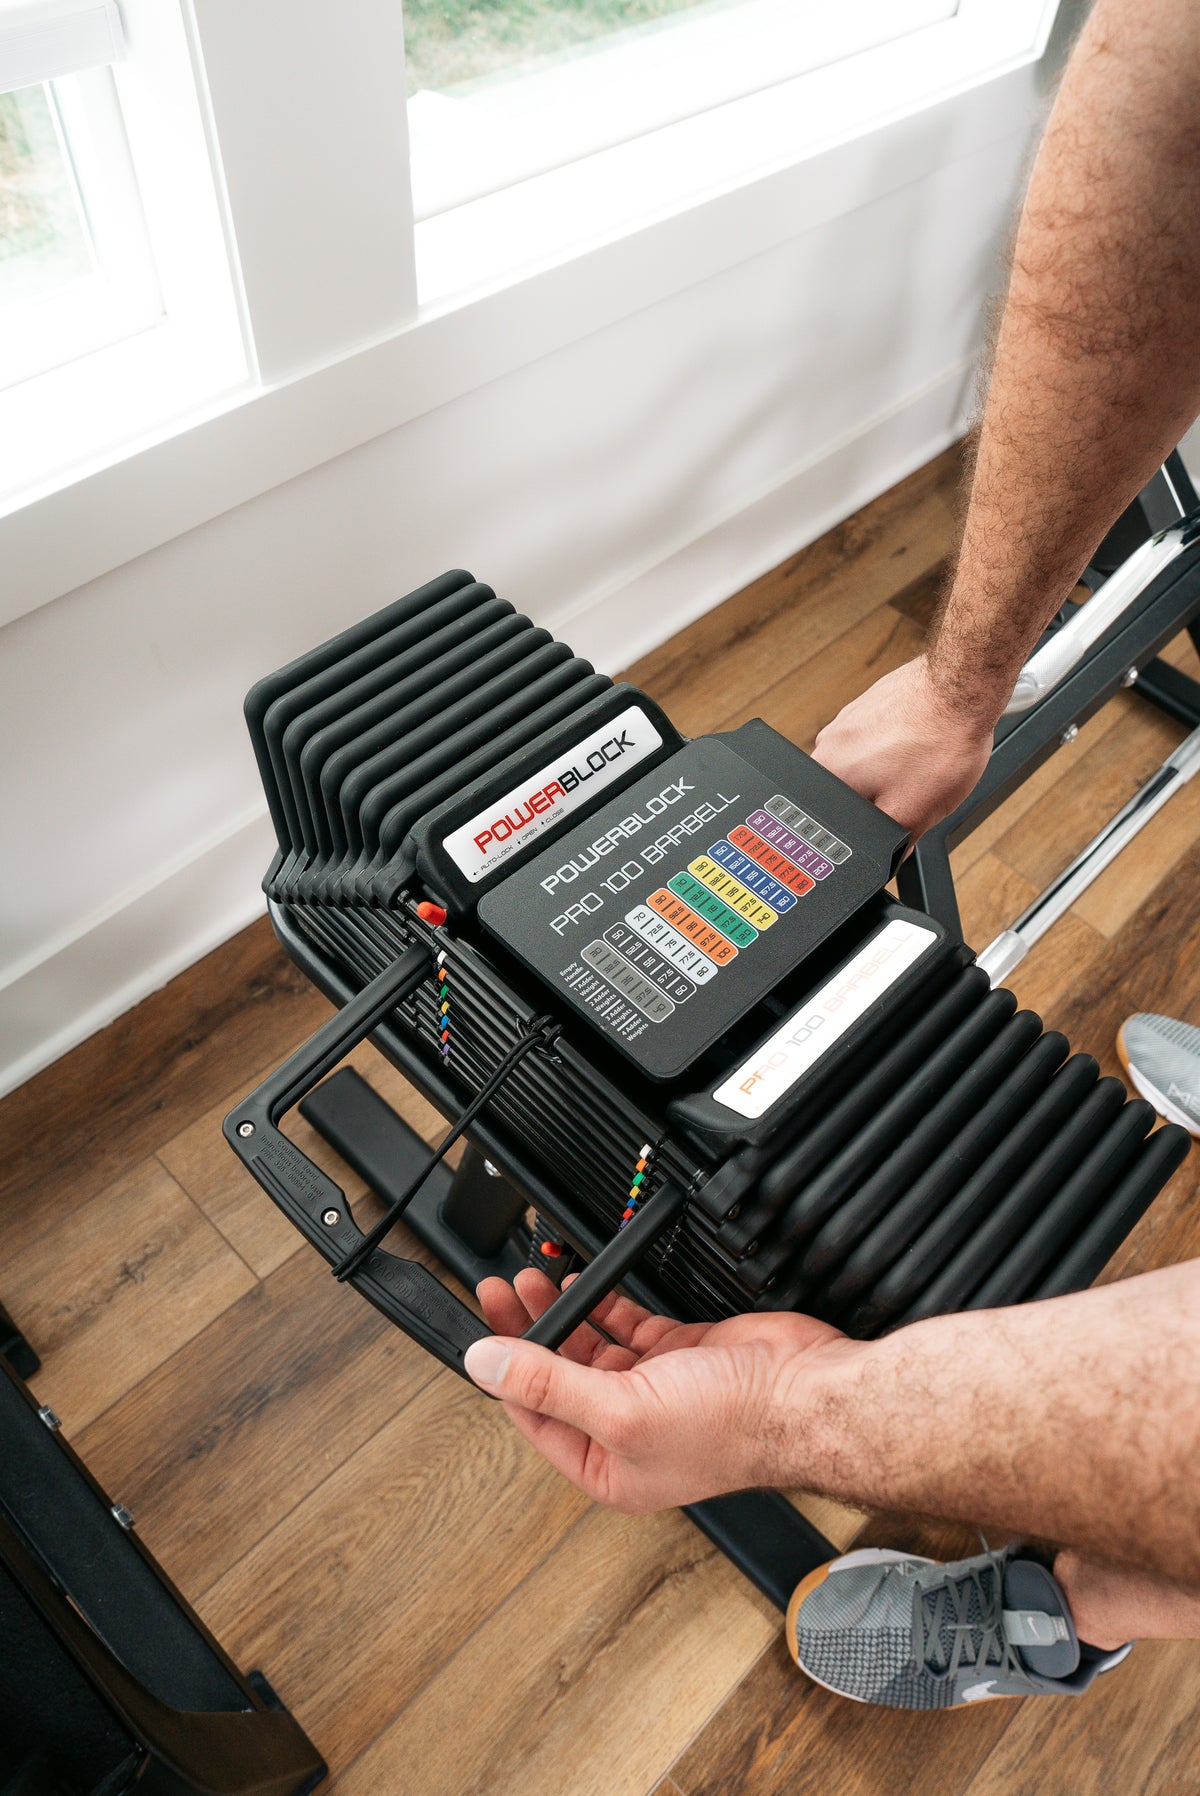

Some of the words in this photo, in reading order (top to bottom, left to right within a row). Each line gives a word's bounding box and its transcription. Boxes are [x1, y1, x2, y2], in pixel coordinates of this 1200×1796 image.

[473, 730, 636, 854] POWERBLOCK
[480, 845, 514, 871] AUTO-LOCK
[521, 827, 538, 841] OPEN
[545, 807, 565, 824] CLOSE
[540, 776, 696, 895] POWERBLOCK
[549, 892, 604, 936] PRO
[600, 860, 644, 895] 100
[640, 792, 741, 865] BARBELL
[589, 947, 602, 958] 30
[611, 929, 624, 940] 50
[633, 912, 646, 921] 70
[655, 894, 667, 905] 90
[695, 861, 708, 872] 130
[714, 845, 728, 856] 150
[734, 830, 747, 840] 170
[626, 941, 642, 956] 52.5
[647, 924, 663, 936] 72.5
[668, 906, 685, 920] 92.5
[709, 872, 725, 886] 132.5
[748, 841, 764, 854] 172.5
[643, 956, 656, 968] 55
[664, 939, 677, 948] 75
[686, 920, 698, 932] 95
[726, 886, 740, 899] 135
[765, 854, 778, 865] 175
[653, 1003, 666, 1013] 40
[675, 984, 688, 996] 60
[696, 966, 709, 977] 80
[716, 947, 731, 959] 100
[736, 929, 751, 941] 120
[757, 912, 771, 924] 140
[776, 896, 790, 907] 160
[813, 862, 828, 876] 200
[657, 969, 674, 983] 57.5
[679, 951, 695, 964] 77.5
[700, 933, 716, 946] 97.5
[740, 898, 757, 912] 137.5
[778, 866, 795, 879] 177.5
[560, 962, 577, 976] Empty
[564, 966, 583, 982] Handle
[578, 975, 594, 989] Adder
[580, 980, 599, 996] Weight
[594, 989, 610, 1003] Adder
[594, 994, 616, 1011] Weights
[610, 1003, 625, 1017] Adder
[738, 1051, 789, 1095] PRO
[785, 1014, 825, 1047] 100
[822, 932, 913, 1013] BARBELL
[610, 1008, 633, 1027] Weights
[626, 1017, 643, 1033] Adder
[626, 1023, 649, 1042] Weights
